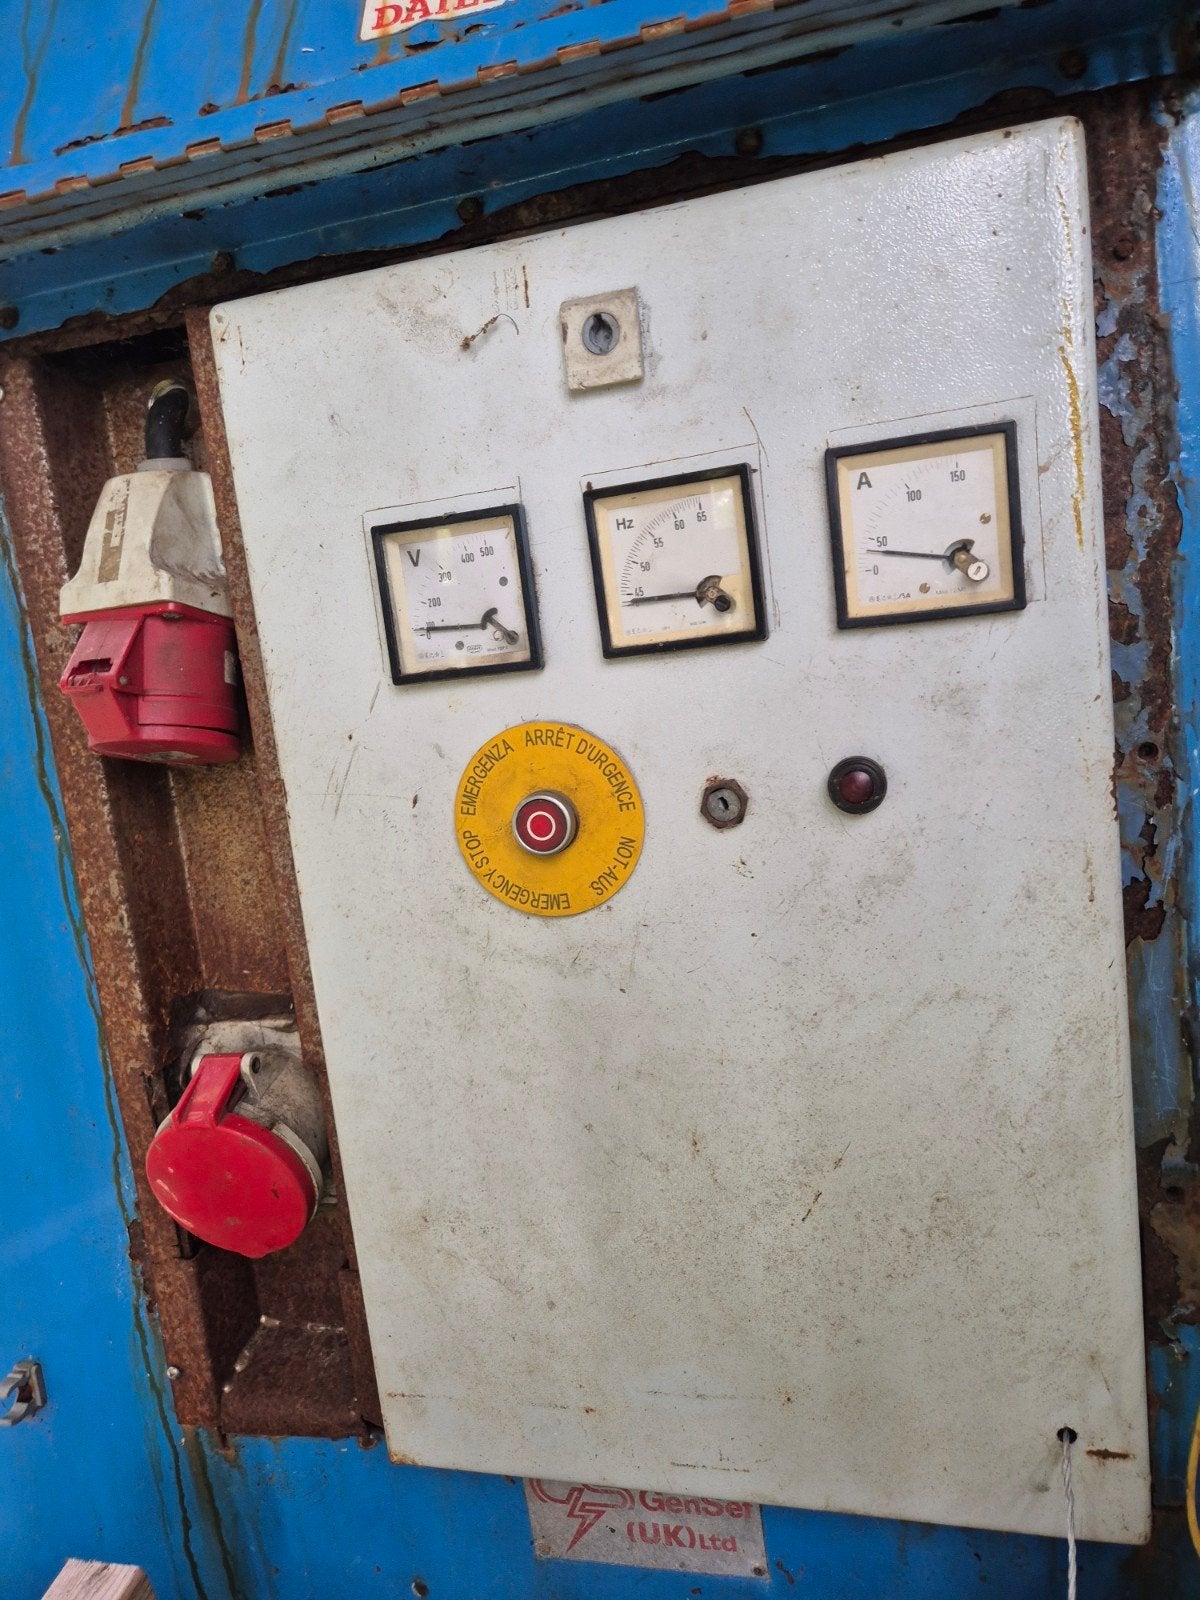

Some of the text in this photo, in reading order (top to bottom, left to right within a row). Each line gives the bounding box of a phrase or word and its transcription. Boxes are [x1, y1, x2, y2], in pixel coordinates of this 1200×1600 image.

[857, 472, 872, 490] A
[950, 470, 966, 482] 150
[906, 489, 922, 502] 100
[697, 511, 707, 522] 65
[616, 518, 634, 531] Hz
[675, 519, 685, 531] 60
[653, 537, 664, 549] 55
[876, 536, 888, 547] 50
[479, 546, 494, 557] 500
[407, 549, 420, 567] V
[461, 553, 475, 563] 400
[640, 562, 650, 572] 50
[438, 571, 451, 583] 300
[428, 597, 442, 608] 200
[525, 727, 636, 813] ARRÊT D'URGENCE
[460, 739, 515, 816] EMERGENZA
[463, 830, 571, 910] EMERGENCY STOP
[590, 836, 636, 896] NOT-AUS
